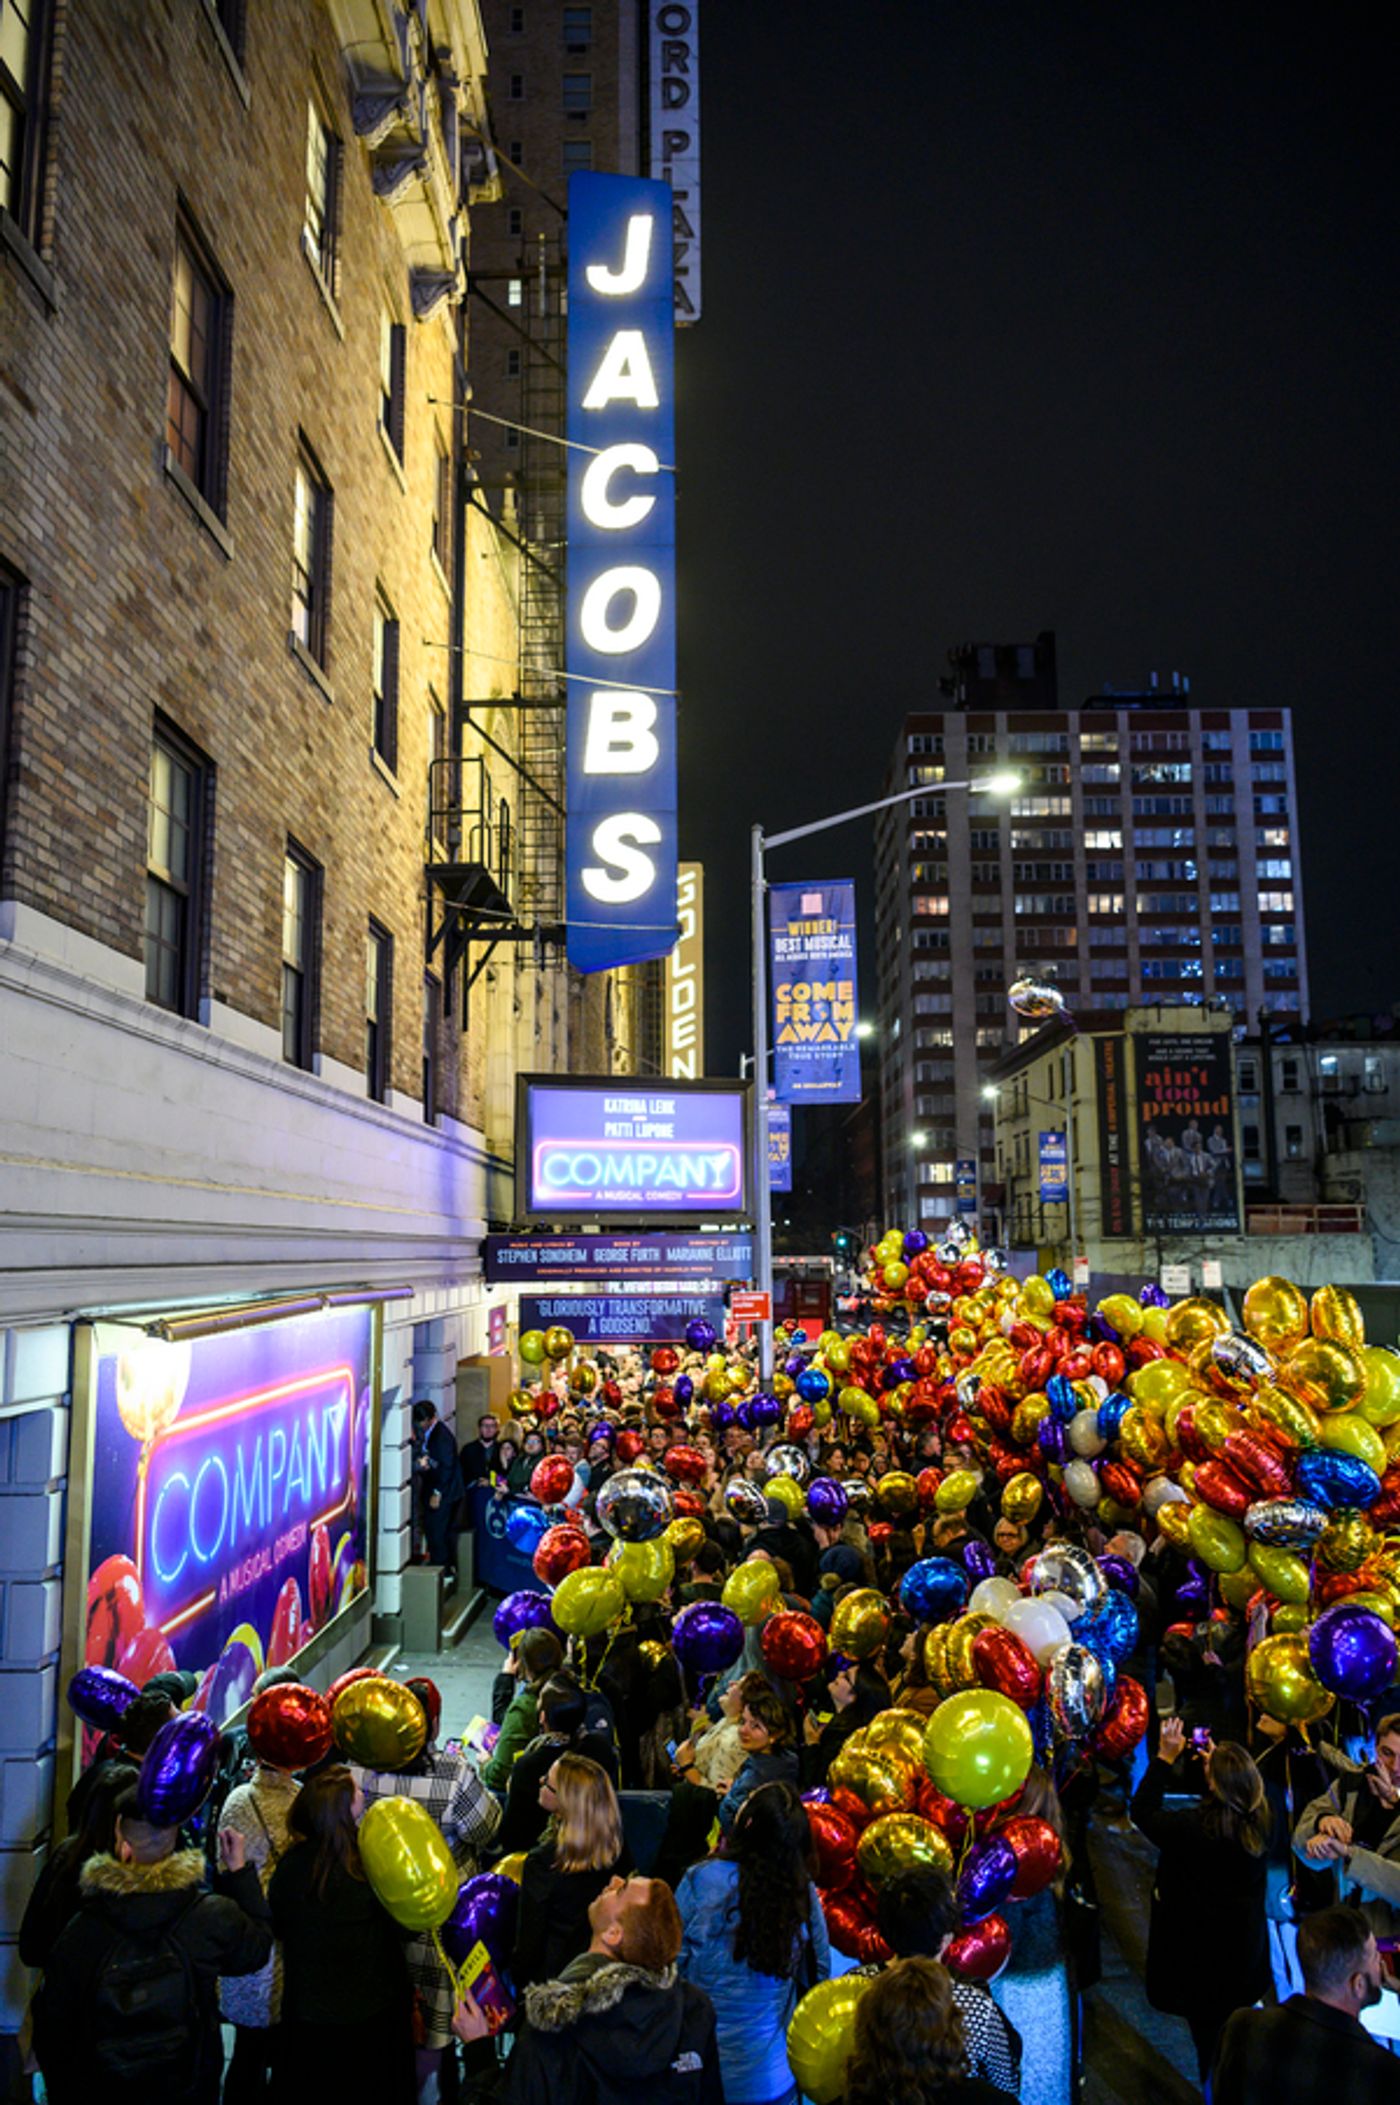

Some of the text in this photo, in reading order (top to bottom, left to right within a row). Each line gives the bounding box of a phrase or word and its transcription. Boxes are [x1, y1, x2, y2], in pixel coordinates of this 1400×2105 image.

[580, 213, 663, 905] JACOBS
[805, 934, 853, 952] MUSICAL
[672, 871, 697, 1080] GOLDEN
[775, 980, 854, 1003] COME
[776, 1001, 854, 1024] FROM
[776, 1021, 855, 1044] AWAY
[1144, 1064, 1208, 1088] ain't
[604, 1098, 647, 1114] KATRINA
[1155, 1086, 1200, 1103] too
[1142, 1094, 1229, 1122] proud
[604, 1121, 633, 1138] PATTI
[1107, 1134, 1119, 1151] THE
[543, 1151, 731, 1188] COMPANY
[497, 1247, 587, 1264] STEPHEN SONDHEIM
[593, 1246, 660, 1262] GEORGE FURTH
[667, 1245, 752, 1261] MARIANNE ELLIOTT
[588, 1318, 597, 1334] A
[151, 1388, 349, 1584] COMPANY
[219, 1520, 308, 1605] A MUSICAL COMEDY
